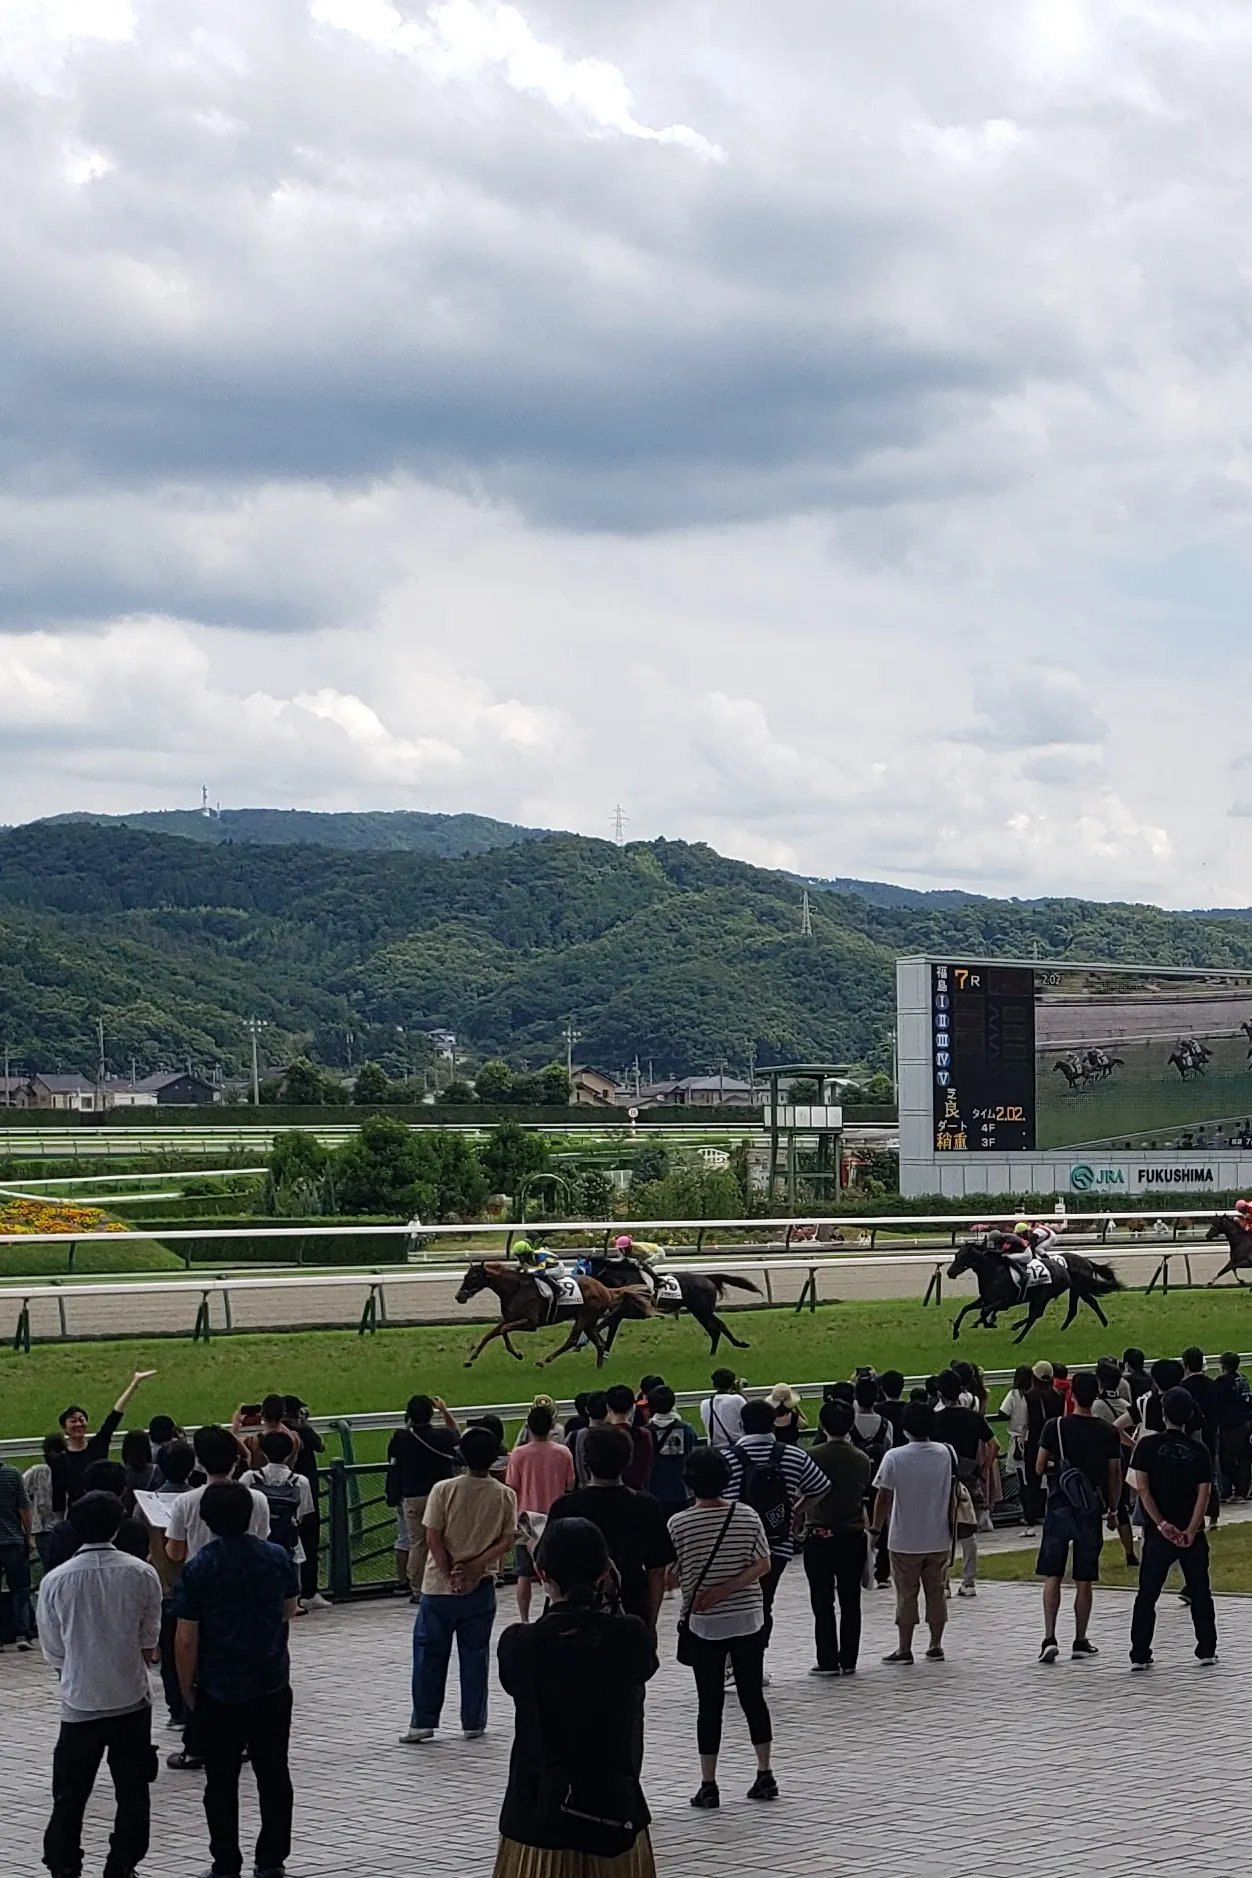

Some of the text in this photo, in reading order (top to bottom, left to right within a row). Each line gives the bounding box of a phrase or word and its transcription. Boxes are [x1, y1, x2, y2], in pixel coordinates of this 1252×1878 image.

[936, 966, 948, 992] 福島
[944, 1100, 960, 1118] 良
[972, 1108, 996, 1119] タイム
[938, 1120, 967, 1131] ダート
[981, 1123, 996, 1132] 4F
[936, 1132, 968, 1150] 稍重
[981, 1138, 996, 1147] 3F
[1096, 1168, 1214, 1184] JRA FUKUSHIMA
[1029, 1265, 1049, 1280] 12
